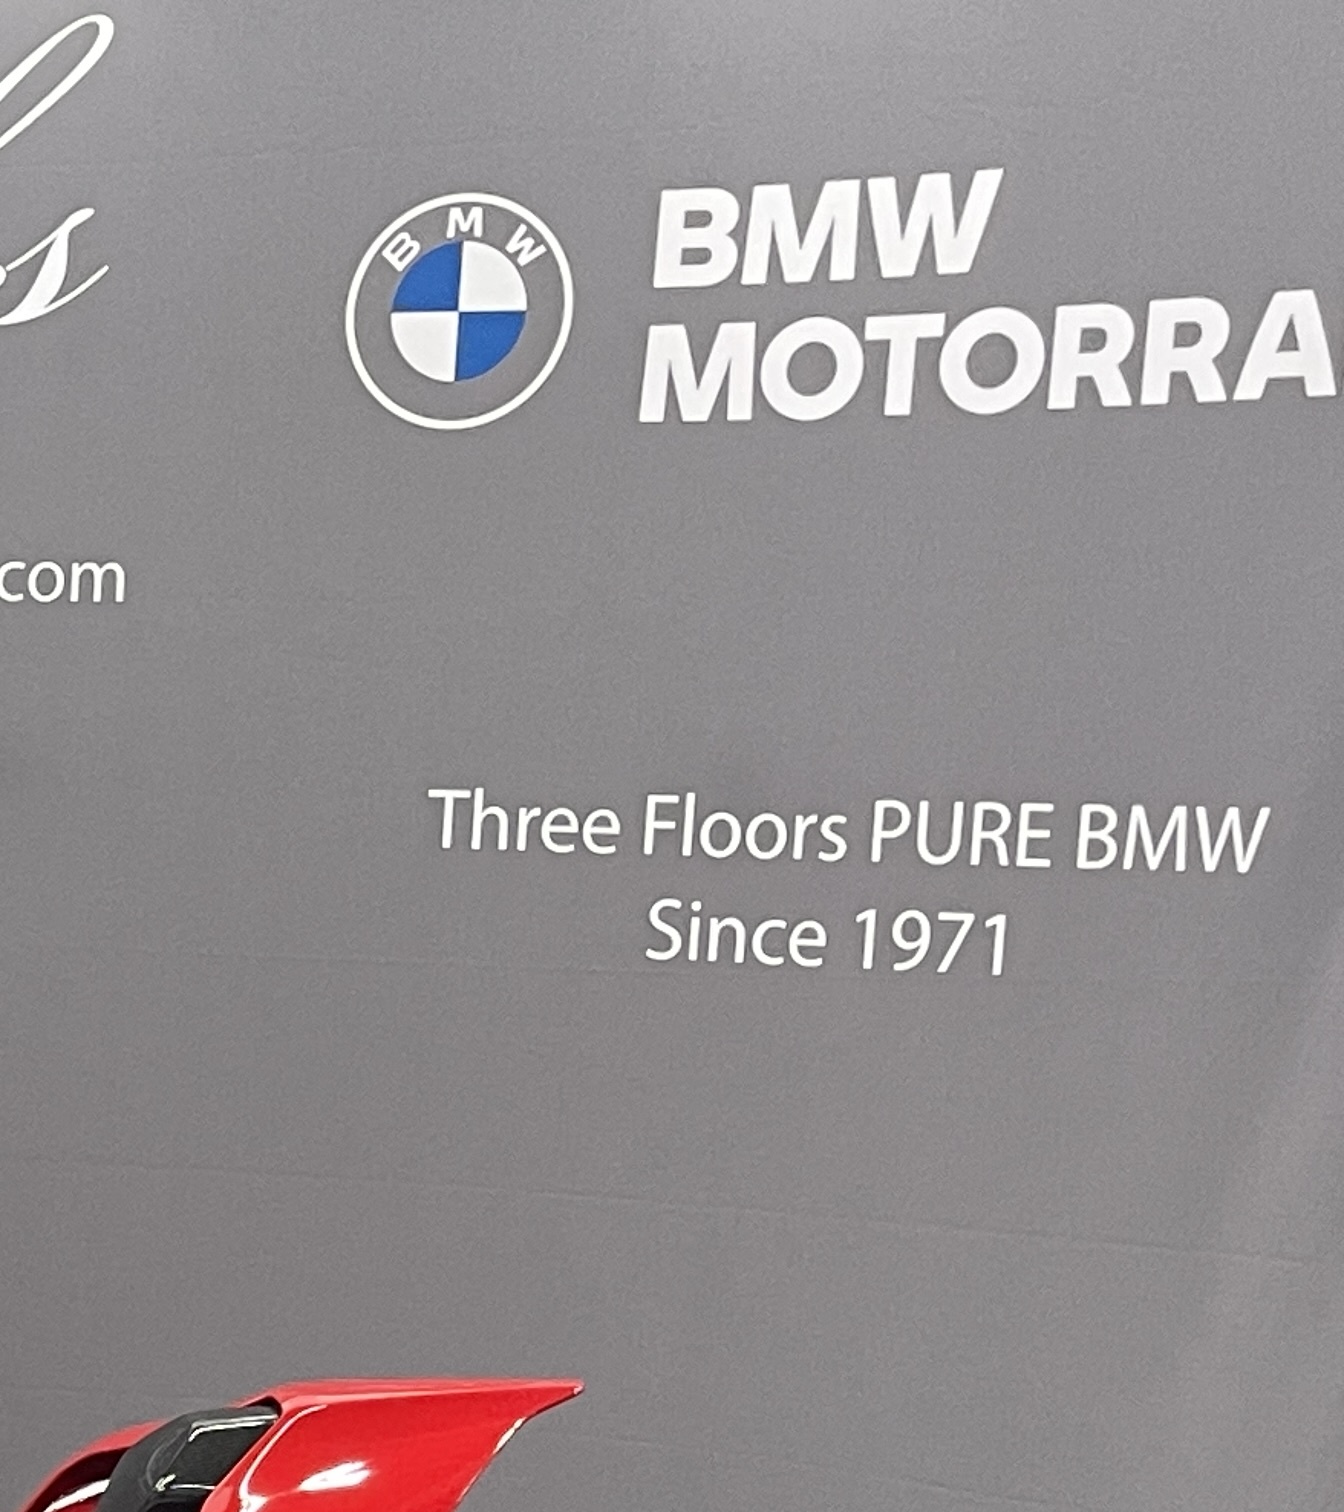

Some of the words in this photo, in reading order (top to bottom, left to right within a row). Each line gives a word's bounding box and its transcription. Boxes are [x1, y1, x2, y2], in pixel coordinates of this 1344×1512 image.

[381, 206, 547, 272] BMW
[653, 167, 1004, 289] BMW
[638, 289, 1338, 423] MOTORRA
[428, 787, 621, 855] Three
[643, 792, 847, 862] Floors
[871, 799, 1054, 868] PURE
[1076, 803, 1271, 874] BMW
[645, 898, 827, 967] Since
[855, 908, 1007, 976] 1971
